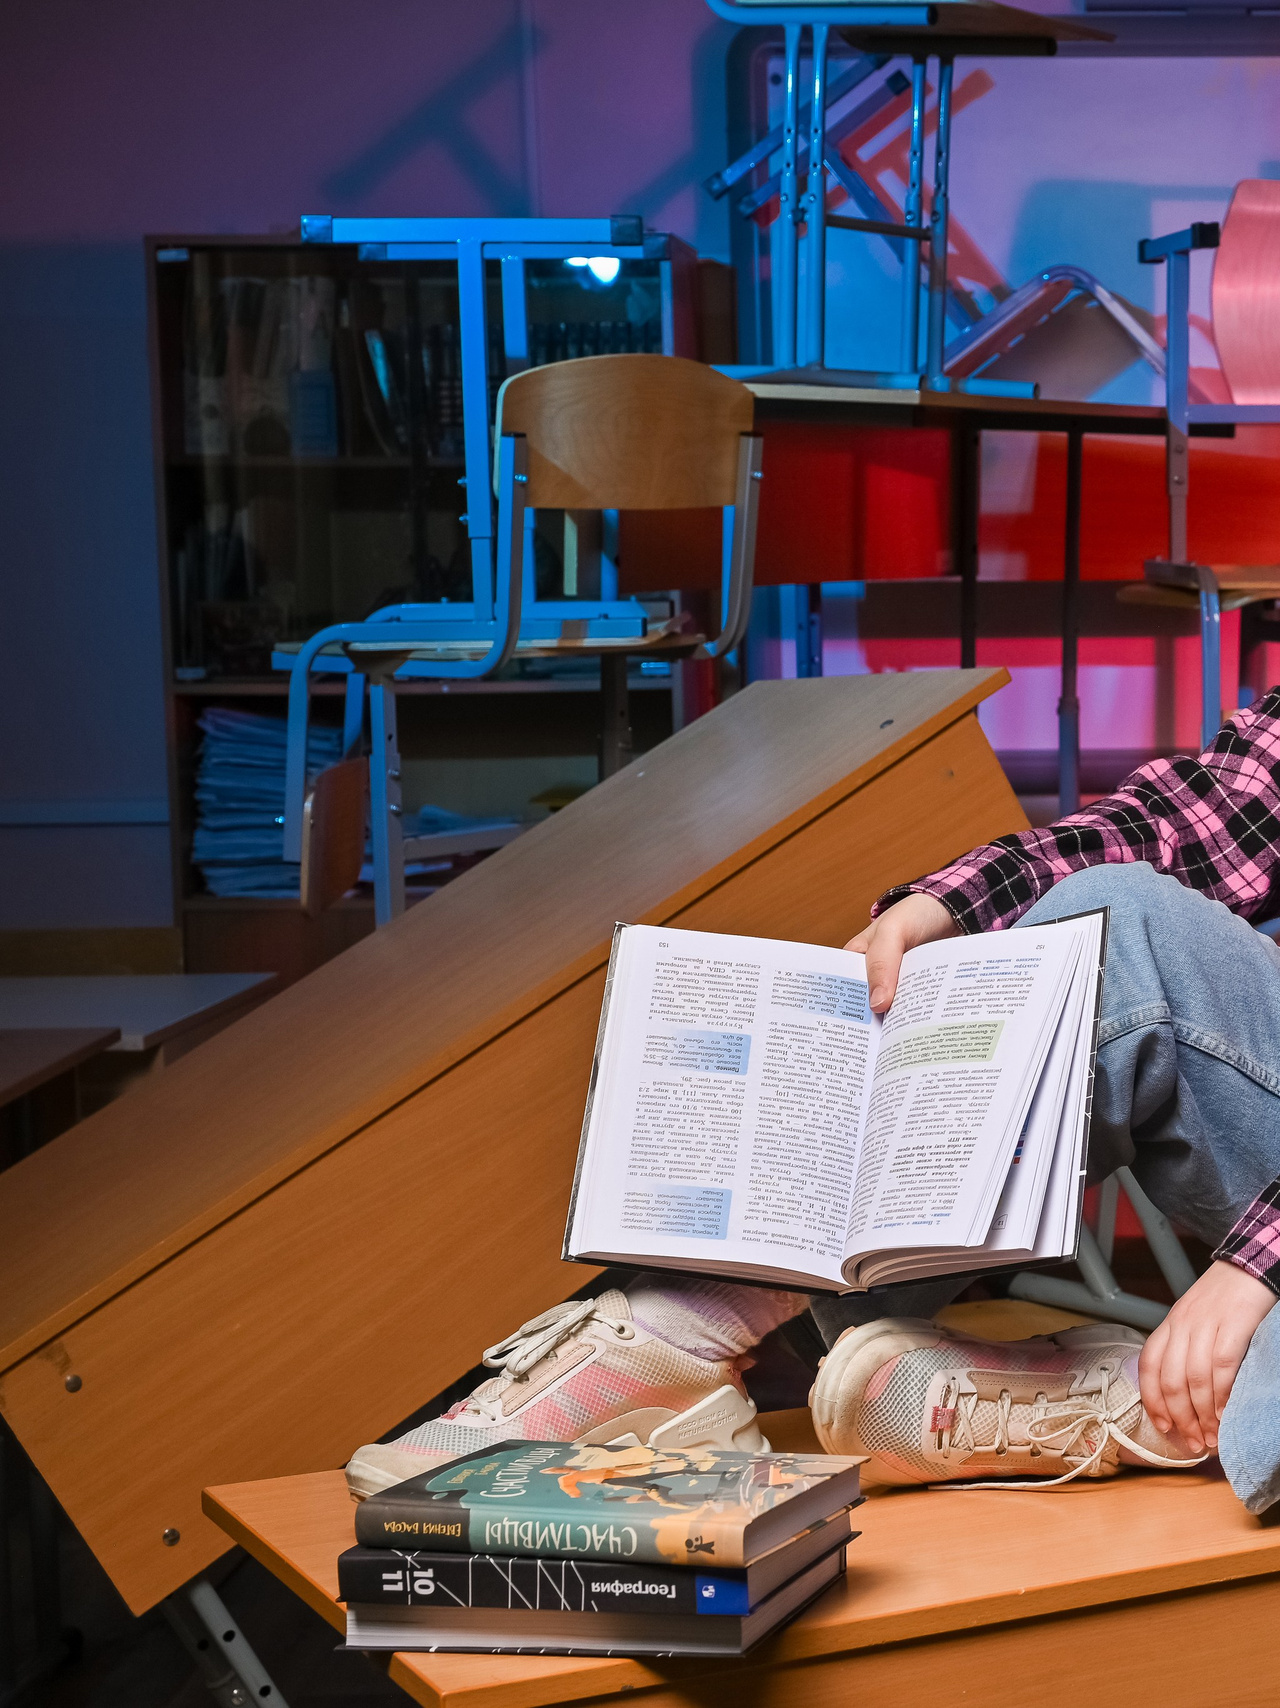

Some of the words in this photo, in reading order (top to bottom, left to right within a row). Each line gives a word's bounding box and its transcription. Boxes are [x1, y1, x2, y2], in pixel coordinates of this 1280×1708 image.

[678, 1420, 697, 1432] ECCO
[679, 1425, 712, 1440] NATURAL
[712, 1412, 738, 1428] MOTION
[384, 1521, 419, 1535] БАСОВА
[422, 1522, 461, 1537] ЕВГЕНИЯ
[485, 1517, 638, 1556] СЧАСТЛИВЦЫ
[382, 1570, 403, 1592] 11
[413, 1568, 435, 1596] 10
[591, 1581, 677, 1599] География
